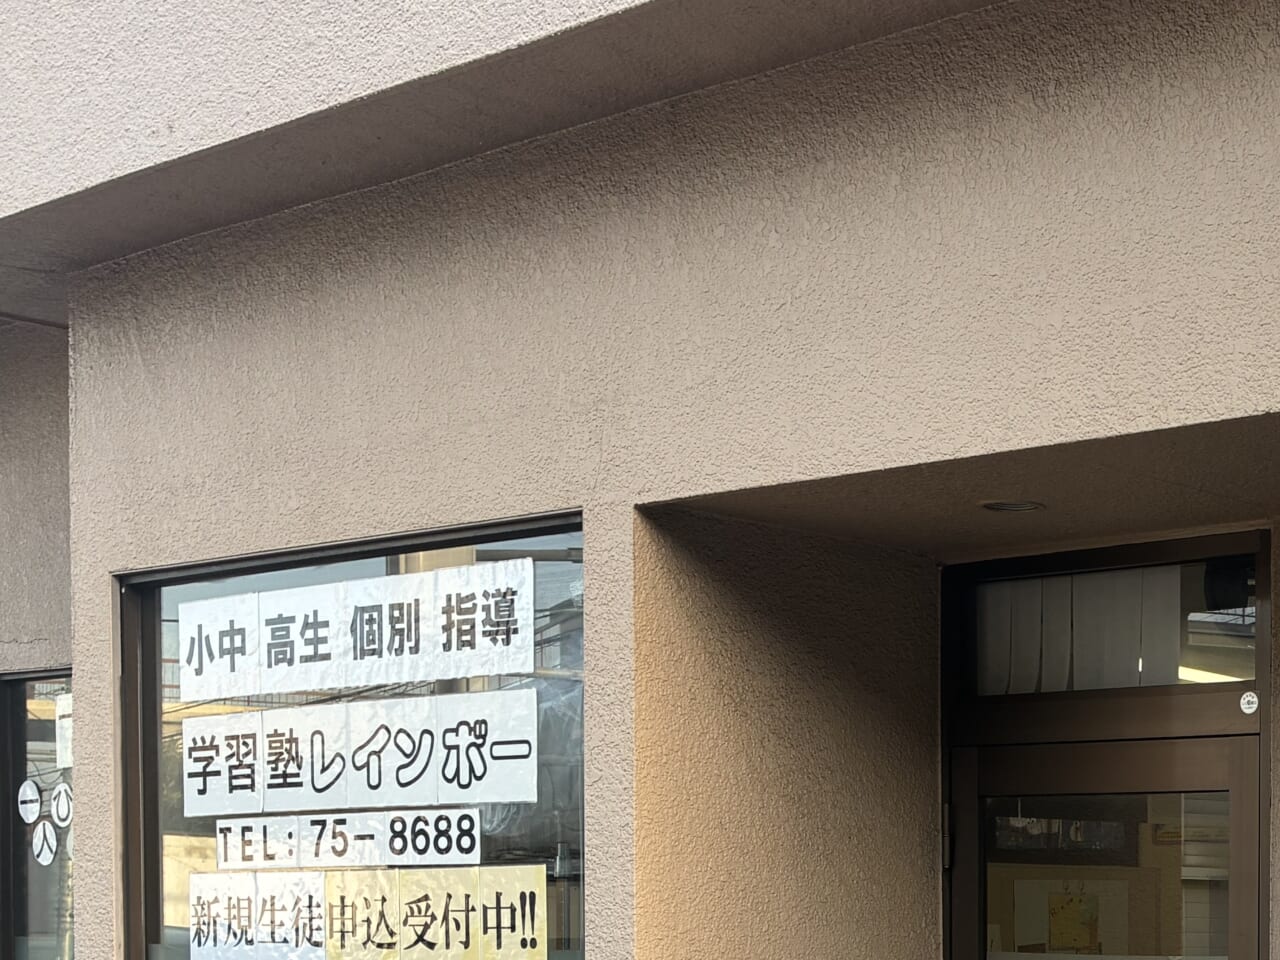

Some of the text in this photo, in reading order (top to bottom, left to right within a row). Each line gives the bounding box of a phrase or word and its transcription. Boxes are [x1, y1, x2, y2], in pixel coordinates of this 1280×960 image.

[187, 719, 532, 796] 学習塾レインボー
[191, 891, 537, 951] 新規生徒申込受付中!!
